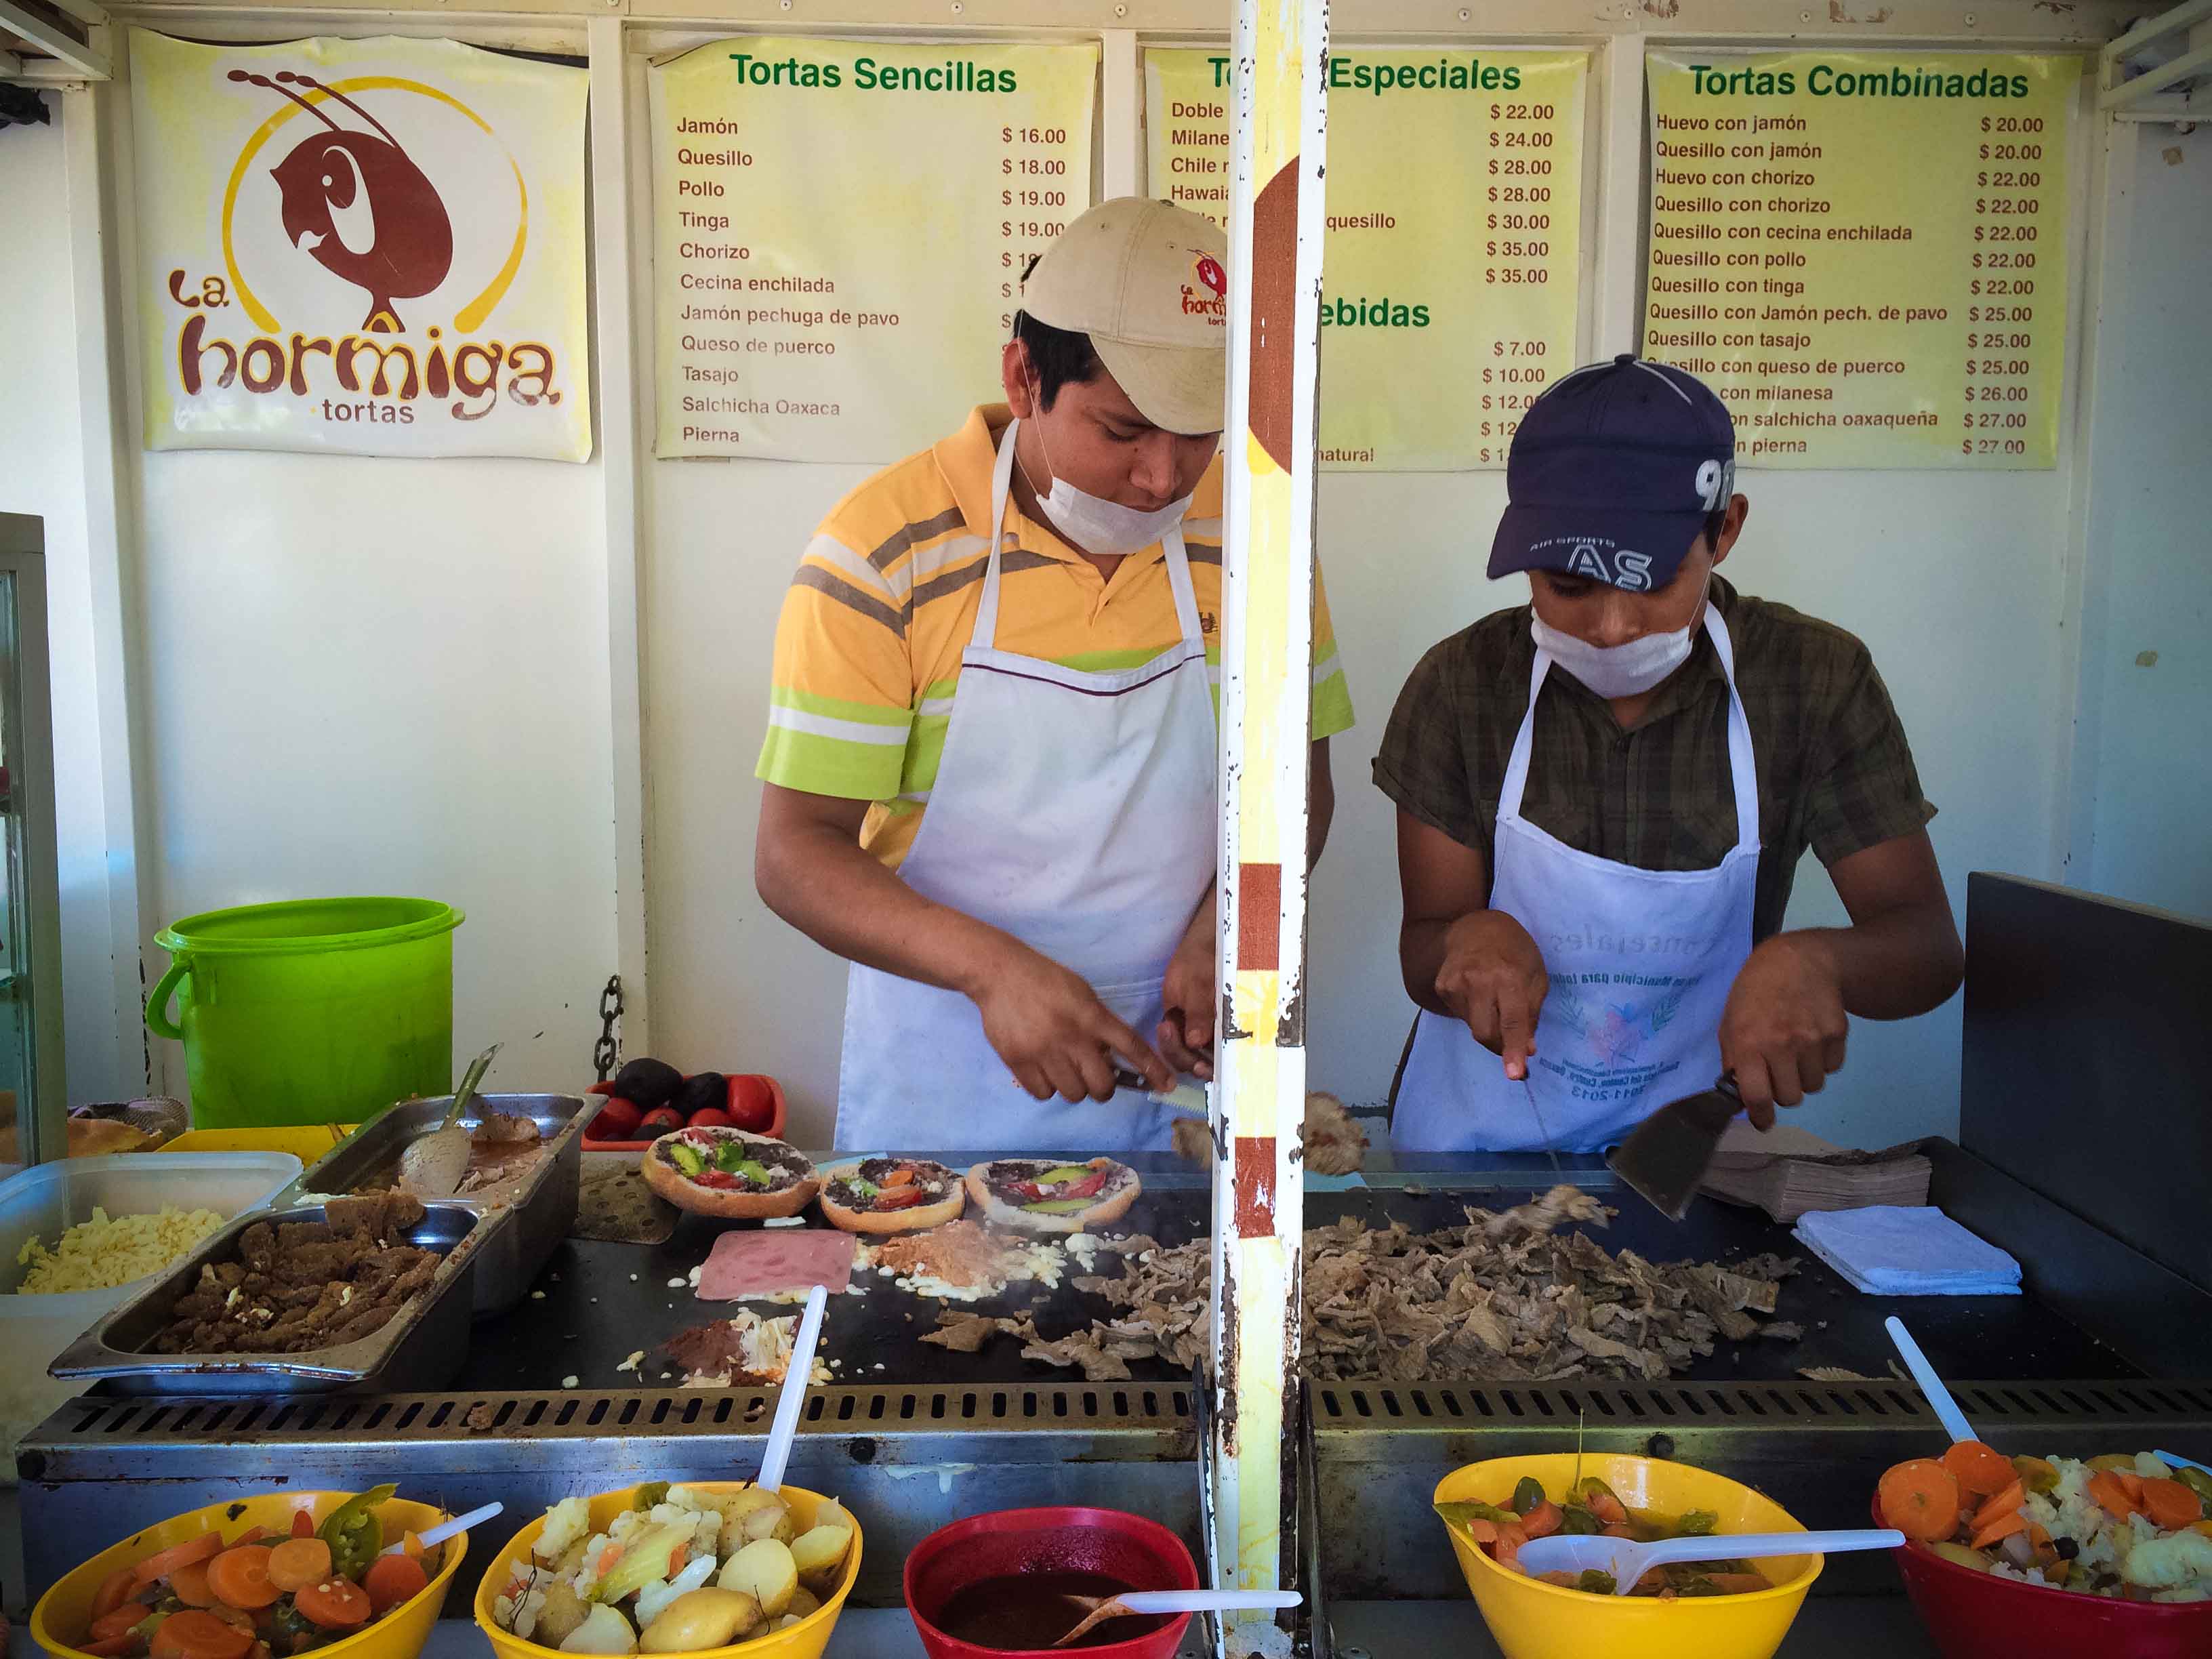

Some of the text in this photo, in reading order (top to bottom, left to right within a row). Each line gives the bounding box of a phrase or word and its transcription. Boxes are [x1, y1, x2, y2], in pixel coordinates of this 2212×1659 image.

[729, 54, 1017, 92] Tortas Sencillas
[1330, 58, 1520, 96] Especiales
[1689, 65, 2028, 98] Tortas Combinadas
[1172, 103, 1223, 118] Doble
[1491, 104, 1553, 121] $ 22.00
[677, 117, 737, 134] Jamón
[1658, 114, 1806, 134] Huevo con jamón
[1982, 117, 2043, 133] $ 20.00
[1003, 127, 1065, 144] $ 16.00
[1172, 130, 1229, 145] Milane
[1490, 131, 1552, 148] $ 24.00
[678, 149, 752, 165] Quesillo
[1657, 141, 1822, 161] Quesillo con jamón
[1980, 144, 2041, 161] $ 20.00
[1003, 159, 1065, 175] $ 18.00
[1172, 157, 1216, 172] Chile
[1489, 159, 1551, 176] $ 28.00
[1656, 168, 1814, 186] Huevo con chorizo
[1978, 171, 2040, 187] $ 22.00
[680, 180, 724, 197] Pollo
[1172, 185, 1228, 200] Hawai
[1489, 186, 1550, 203] $ 28.00
[1002, 190, 1065, 206] $ 19.00
[1656, 196, 1830, 213] Quesillo con chorizo
[1976, 199, 2039, 214] $ 22.00
[679, 212, 729, 231] Tinga
[1002, 221, 1065, 237] $ 19.00
[1327, 213, 1395, 232] quesillo
[1488, 213, 1549, 230] $ 30.00
[1655, 222, 1912, 240] Quesillo con cecina enchilada
[1974, 226, 2036, 242] $ 22.00
[680, 243, 749, 259] Chorizo
[1487, 241, 1549, 257] $ 35.00
[1002, 252, 1011, 268] $
[1654, 249, 1805, 269] Quesillo con pollo
[1973, 253, 2035, 268] $ 22.00
[681, 274, 834, 293] Cecina enchilada
[1486, 268, 1547, 284] $ 35.00
[1002, 283, 1011, 298] $
[1652, 276, 1803, 297] Quesillo con tinga
[1971, 280, 2033, 295] $ 22.00
[1182, 295, 1226, 316] horm
[1322, 298, 1430, 327] ebidas
[1651, 304, 1947, 324] Quesillo con Jamón pech. de pavo
[1970, 306, 2032, 322] $ 25.00
[681, 305, 899, 328] Jamón pechuga de pavo
[1002, 313, 1011, 328] $
[1208, 316, 1226, 326] tort
[682, 335, 835, 355] Queso de puerco
[1494, 342, 1545, 356] $ 7.00
[1649, 331, 1811, 350] Quesillo con tasajo
[1968, 333, 2030, 349] $ 25.00
[178, 314, 562, 421] hormiga
[682, 366, 738, 385] Tasajo
[1647, 357, 1905, 377] esillo con queso de puerco
[1967, 360, 2029, 375] $ 25.00
[1483, 368, 1544, 384] $ 10.00
[1720, 386, 1832, 400] con milanesa
[1965, 386, 2028, 403] $ 26.00
[323, 398, 414, 424] tortas
[683, 396, 839, 415] Salchicha Oaxaca
[1498, 396, 1540, 409] 12.0
[1730, 411, 1938, 429] on salchicha oaxaqueña
[1964, 413, 2026, 428] $ 27.00
[684, 427, 739, 442] Pierna
[1481, 422, 1490, 436] $
[1481, 448, 1490, 462] $
[1753, 438, 1807, 455] pierna
[1963, 439, 2025, 455] $ 27.00
[1567, 544, 1652, 592] AS
